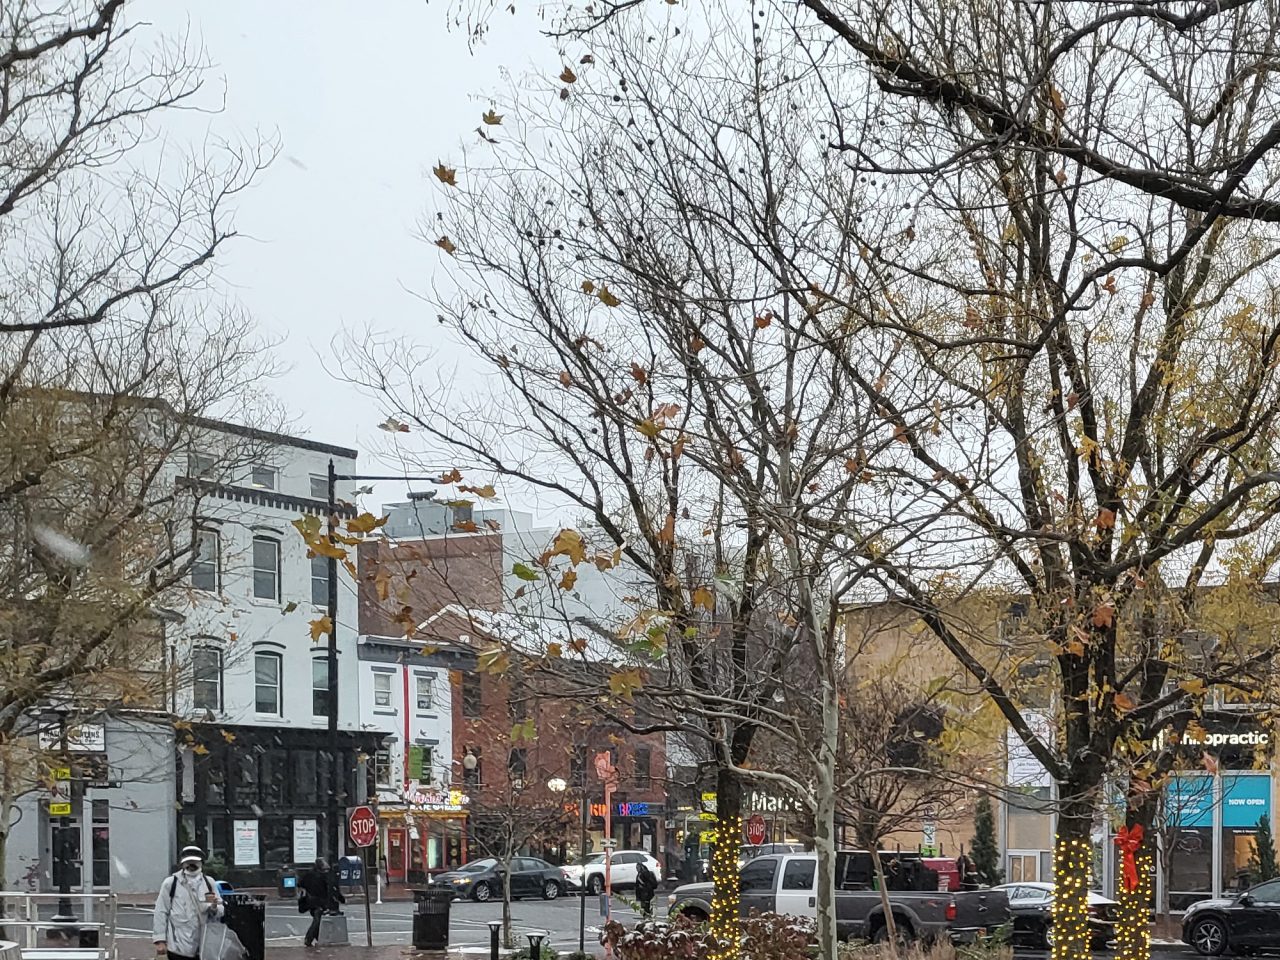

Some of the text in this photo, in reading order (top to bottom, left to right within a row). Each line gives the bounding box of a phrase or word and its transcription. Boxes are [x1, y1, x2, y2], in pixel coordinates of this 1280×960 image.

[1228, 798, 1265, 806] NOW OPEN
[352, 818, 375, 835] STOP
[748, 822, 765, 836] STOP
